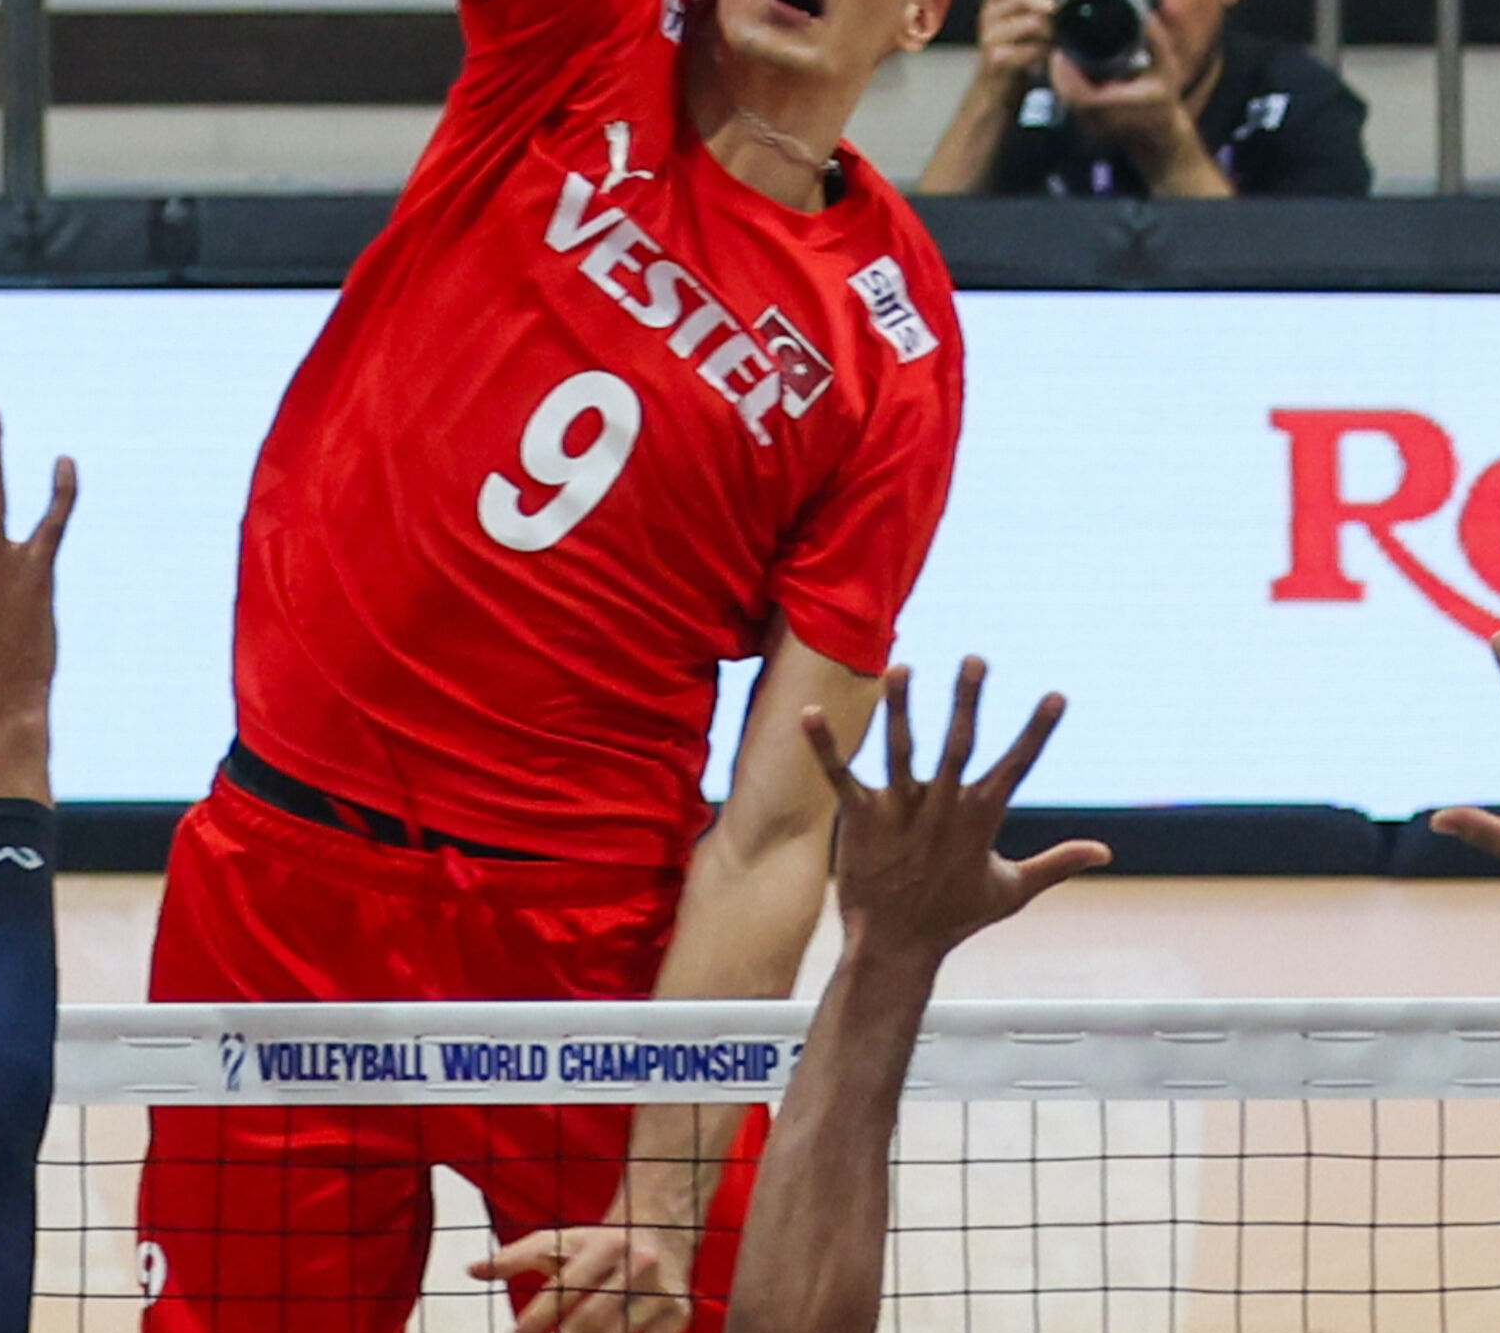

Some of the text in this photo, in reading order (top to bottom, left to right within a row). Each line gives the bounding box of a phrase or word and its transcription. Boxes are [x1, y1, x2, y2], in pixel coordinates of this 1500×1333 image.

[544, 171, 782, 447] VESTEL
[477, 370, 642, 552] 9
[256, 1042, 779, 1082] VOLLEYBALL WORLD CHAMPIONSHIP
